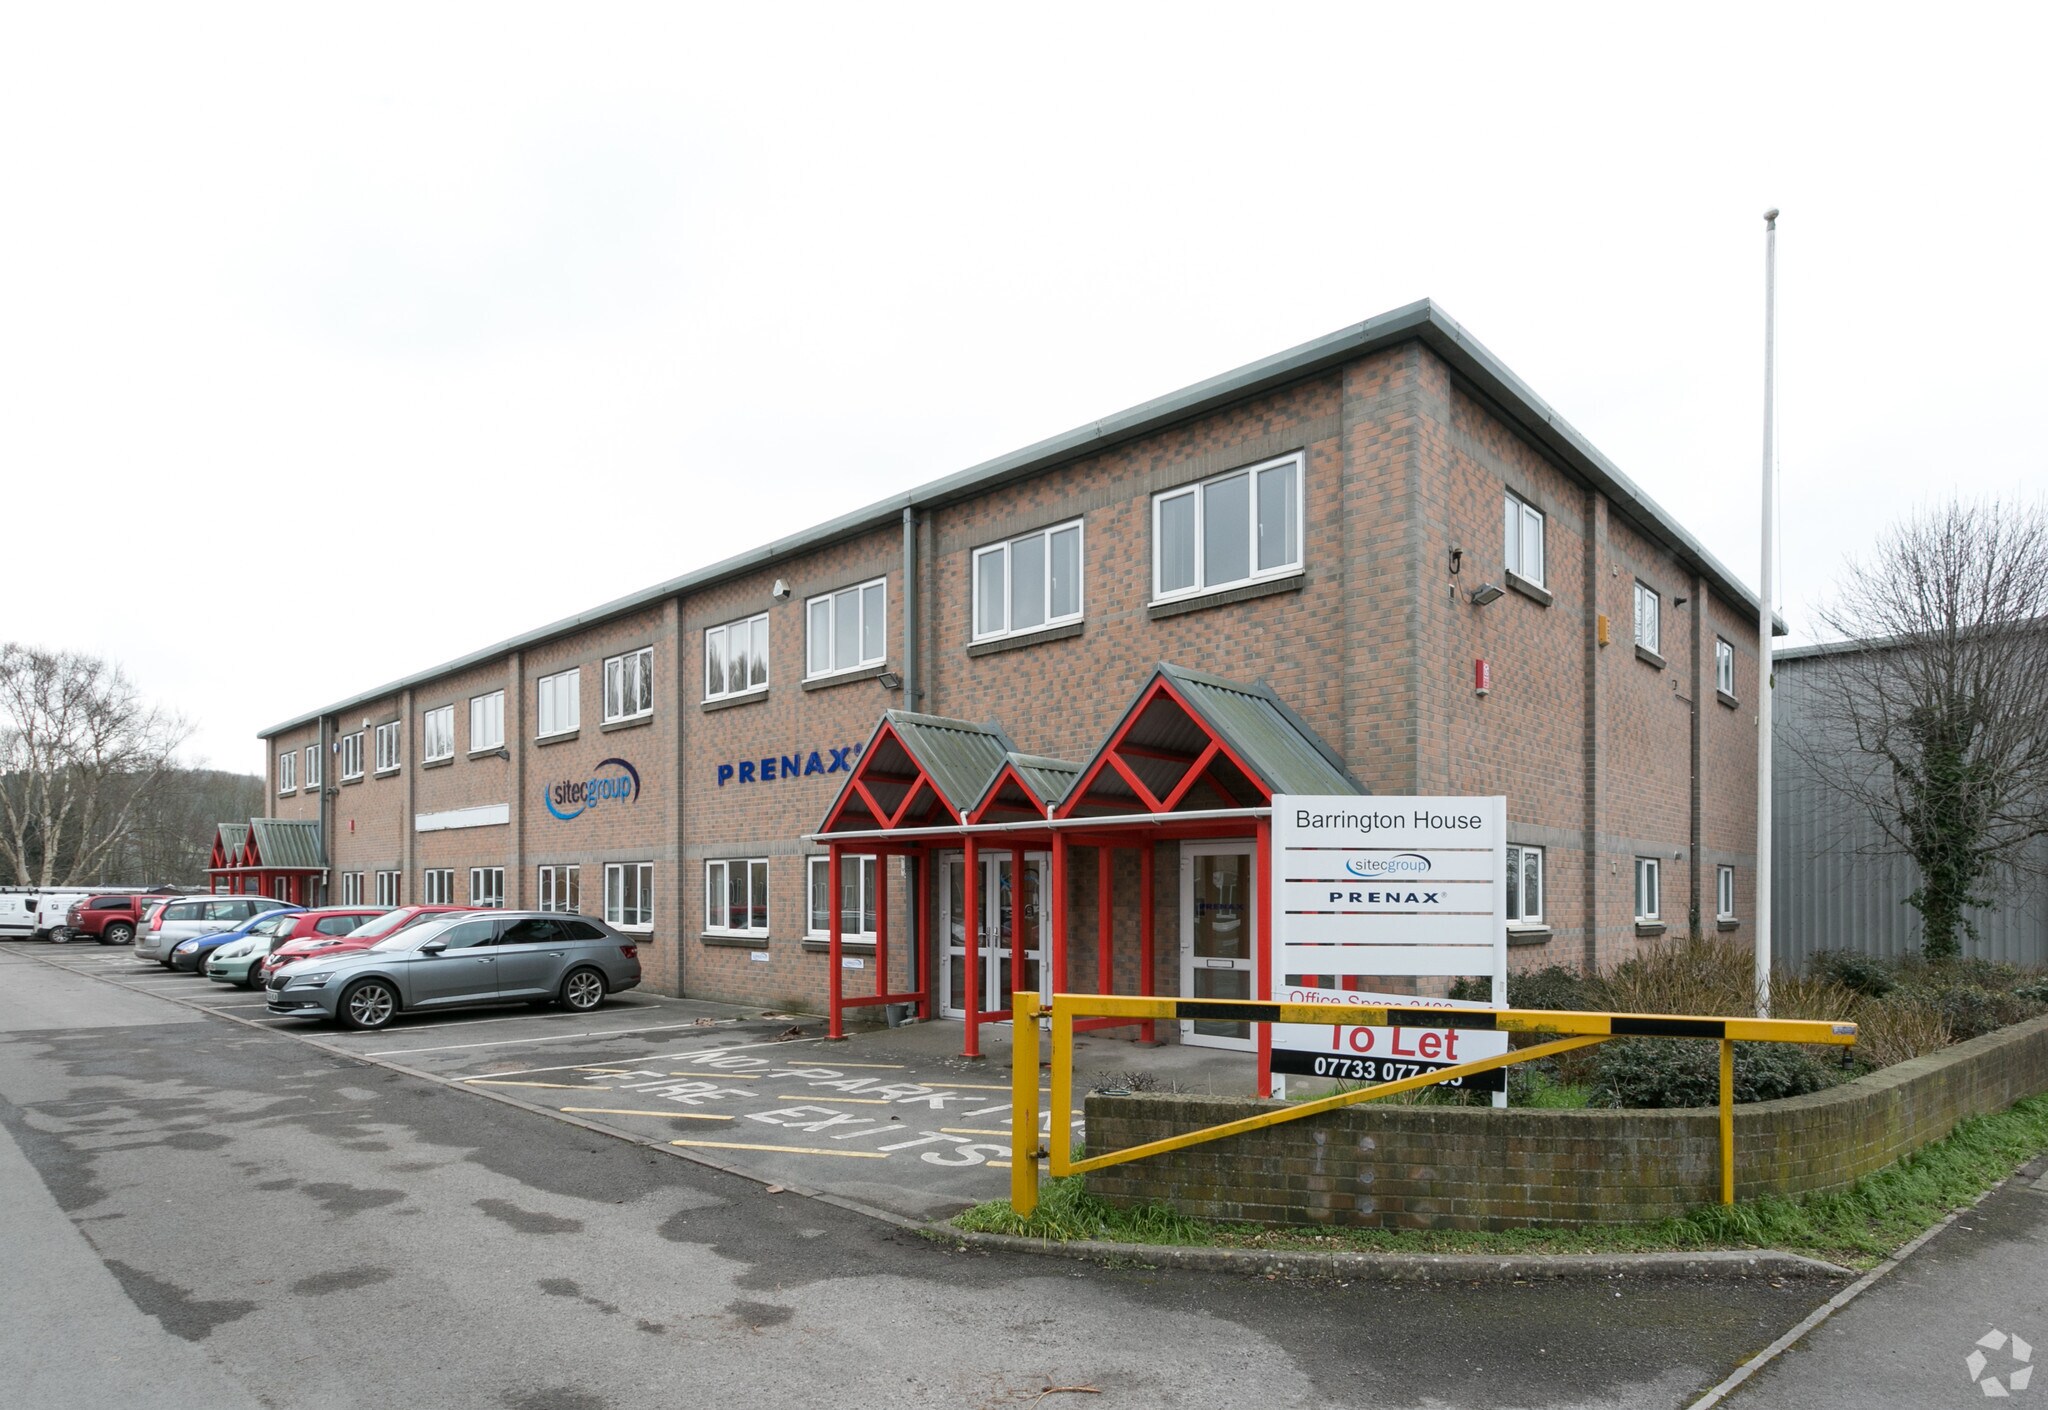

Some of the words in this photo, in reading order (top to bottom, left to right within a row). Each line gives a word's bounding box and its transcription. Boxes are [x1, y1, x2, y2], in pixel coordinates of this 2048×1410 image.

[554, 775, 632, 808] sitecgroup
[1296, 810, 1406, 834] Barrington
[1413, 810, 1482, 830] House
[1355, 858, 1427, 874] sitecgroup
[1391, 1026, 1459, 1061] Let
[1314, 1056, 1376, 1080] 07733
[672, 1051, 769, 1068] NO
[768, 1067, 1086, 1137] PARKIN
[584, 1070, 760, 1105] FIRE
[744, 1105, 1013, 1167] EXITS
